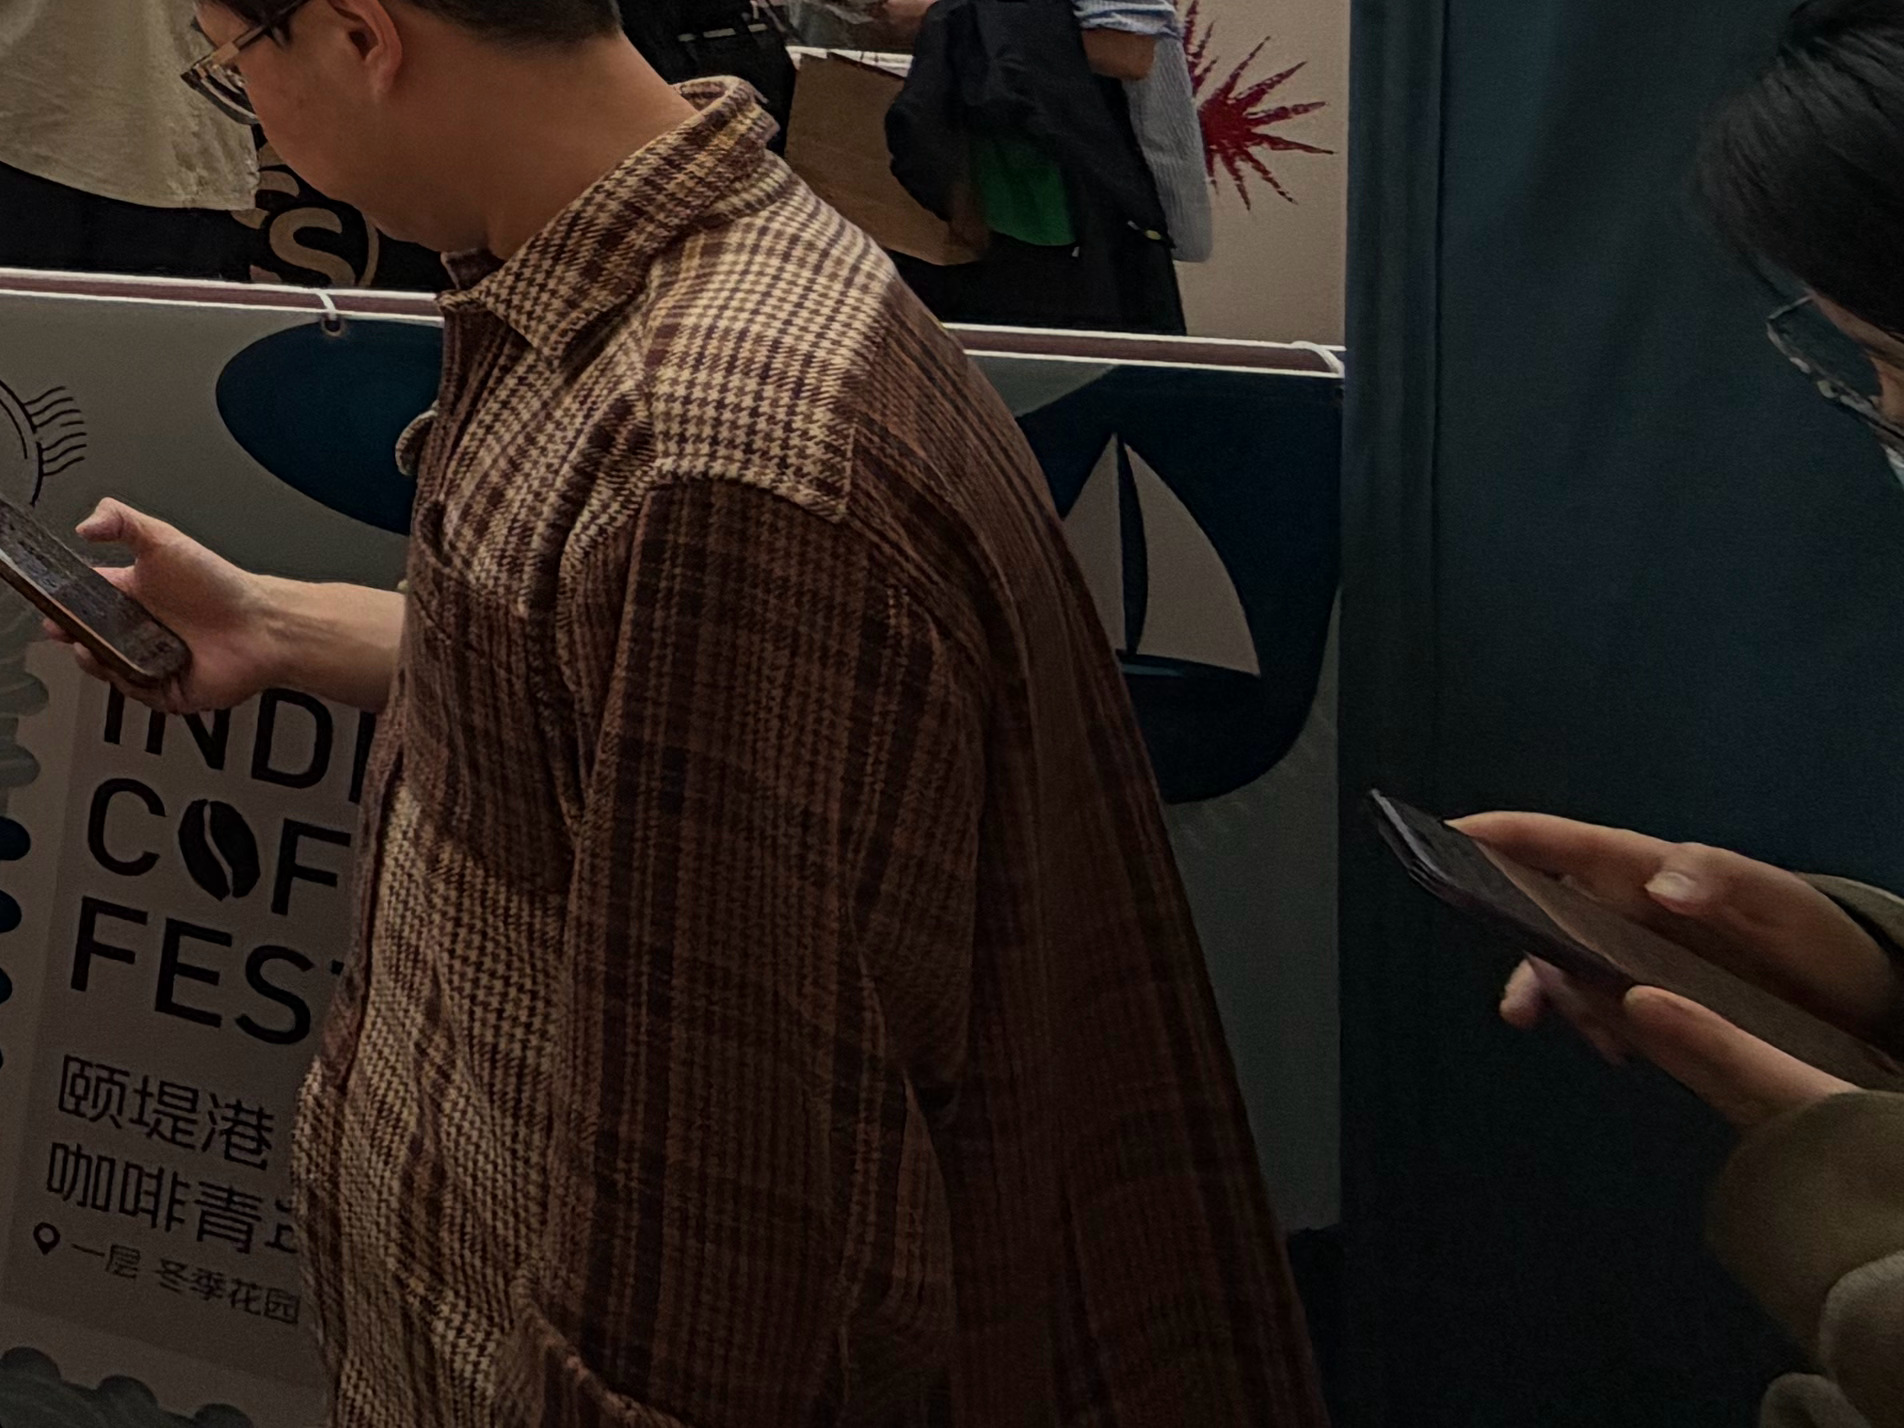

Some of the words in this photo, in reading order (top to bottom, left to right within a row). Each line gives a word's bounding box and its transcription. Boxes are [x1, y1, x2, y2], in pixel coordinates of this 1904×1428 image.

[70, 896, 344, 1045] FES
[58, 1054, 275, 1171] 颐堤港
[71, 1243, 141, 1280] 一层
[155, 1258, 300, 1326] 冬季花园
